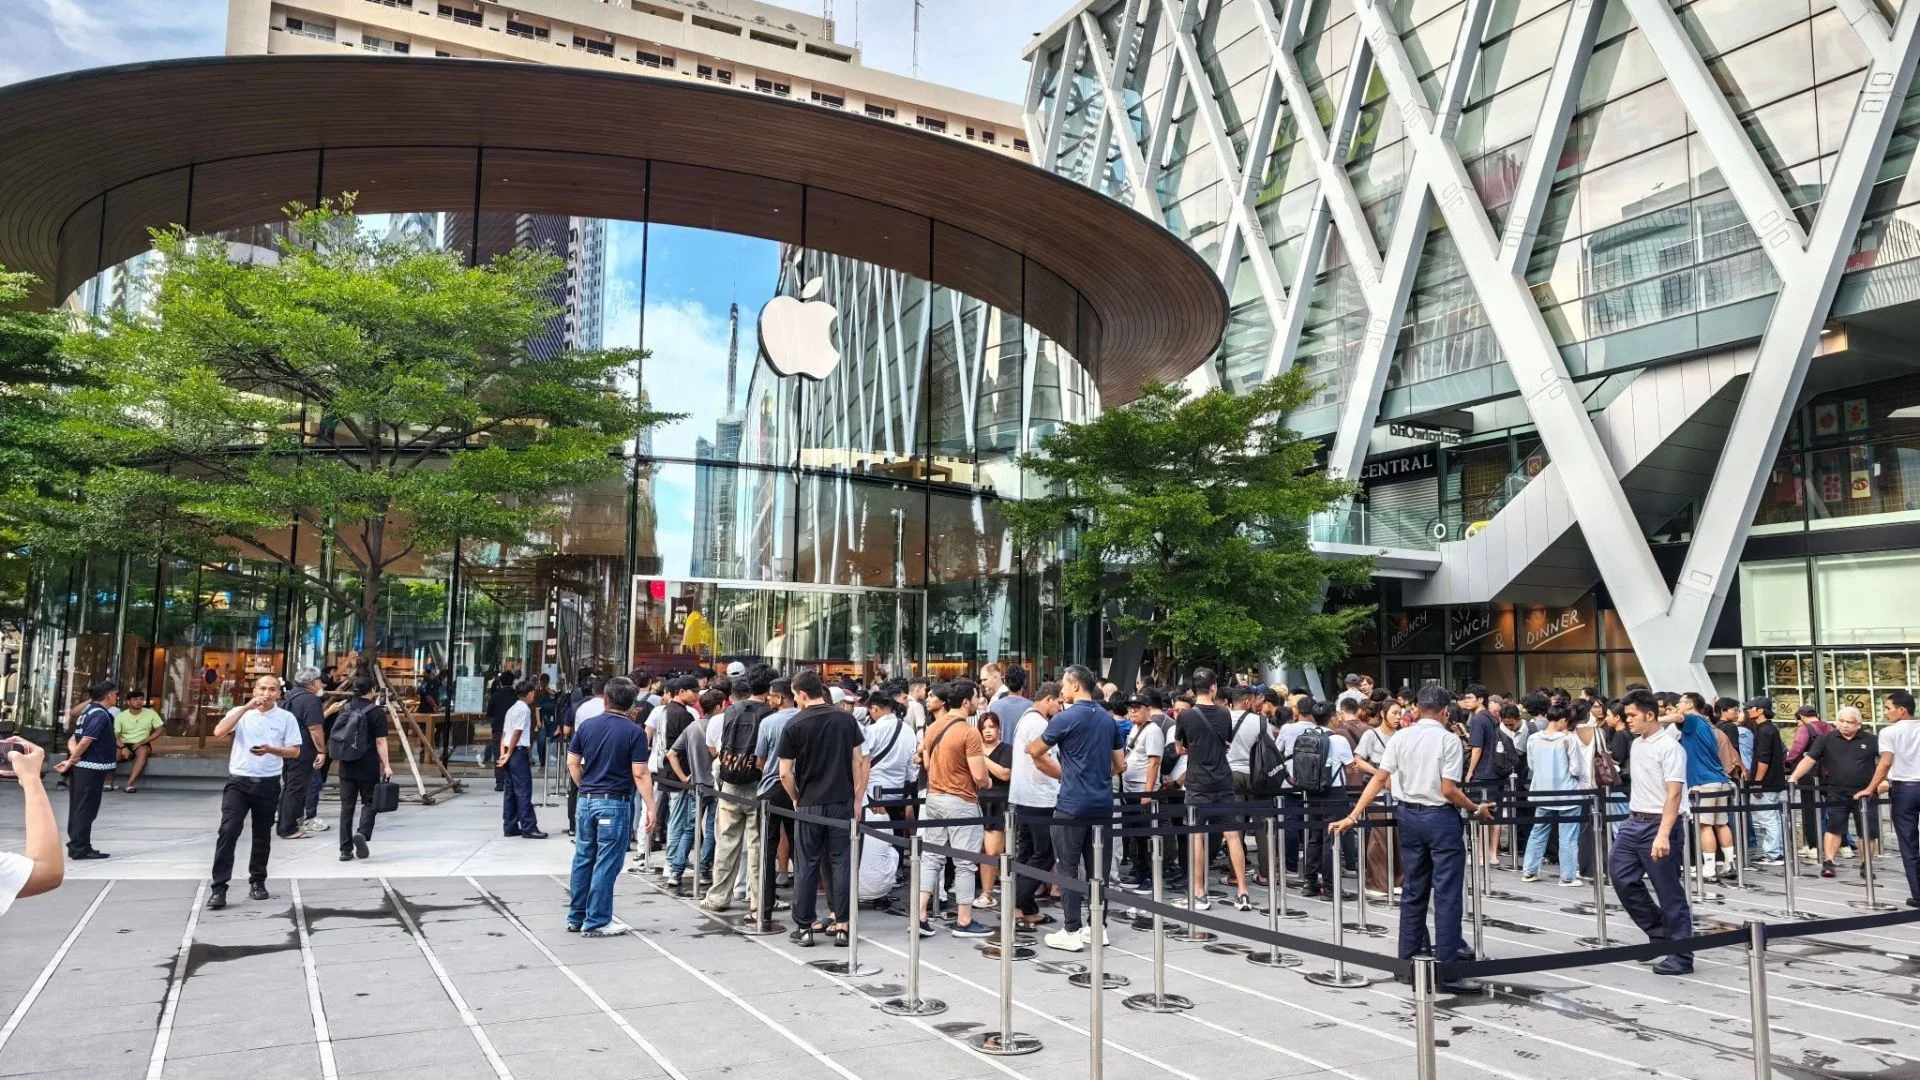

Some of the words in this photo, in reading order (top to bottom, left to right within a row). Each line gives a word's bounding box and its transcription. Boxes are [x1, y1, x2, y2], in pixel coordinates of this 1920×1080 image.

[1360, 454, 1433, 479] CENTRAL
[1391, 609, 1427, 650] BRUNCH
[1450, 612, 1490, 645] LUNCH
[1494, 632, 1504, 649] &
[1526, 609, 1579, 645] DINNER
